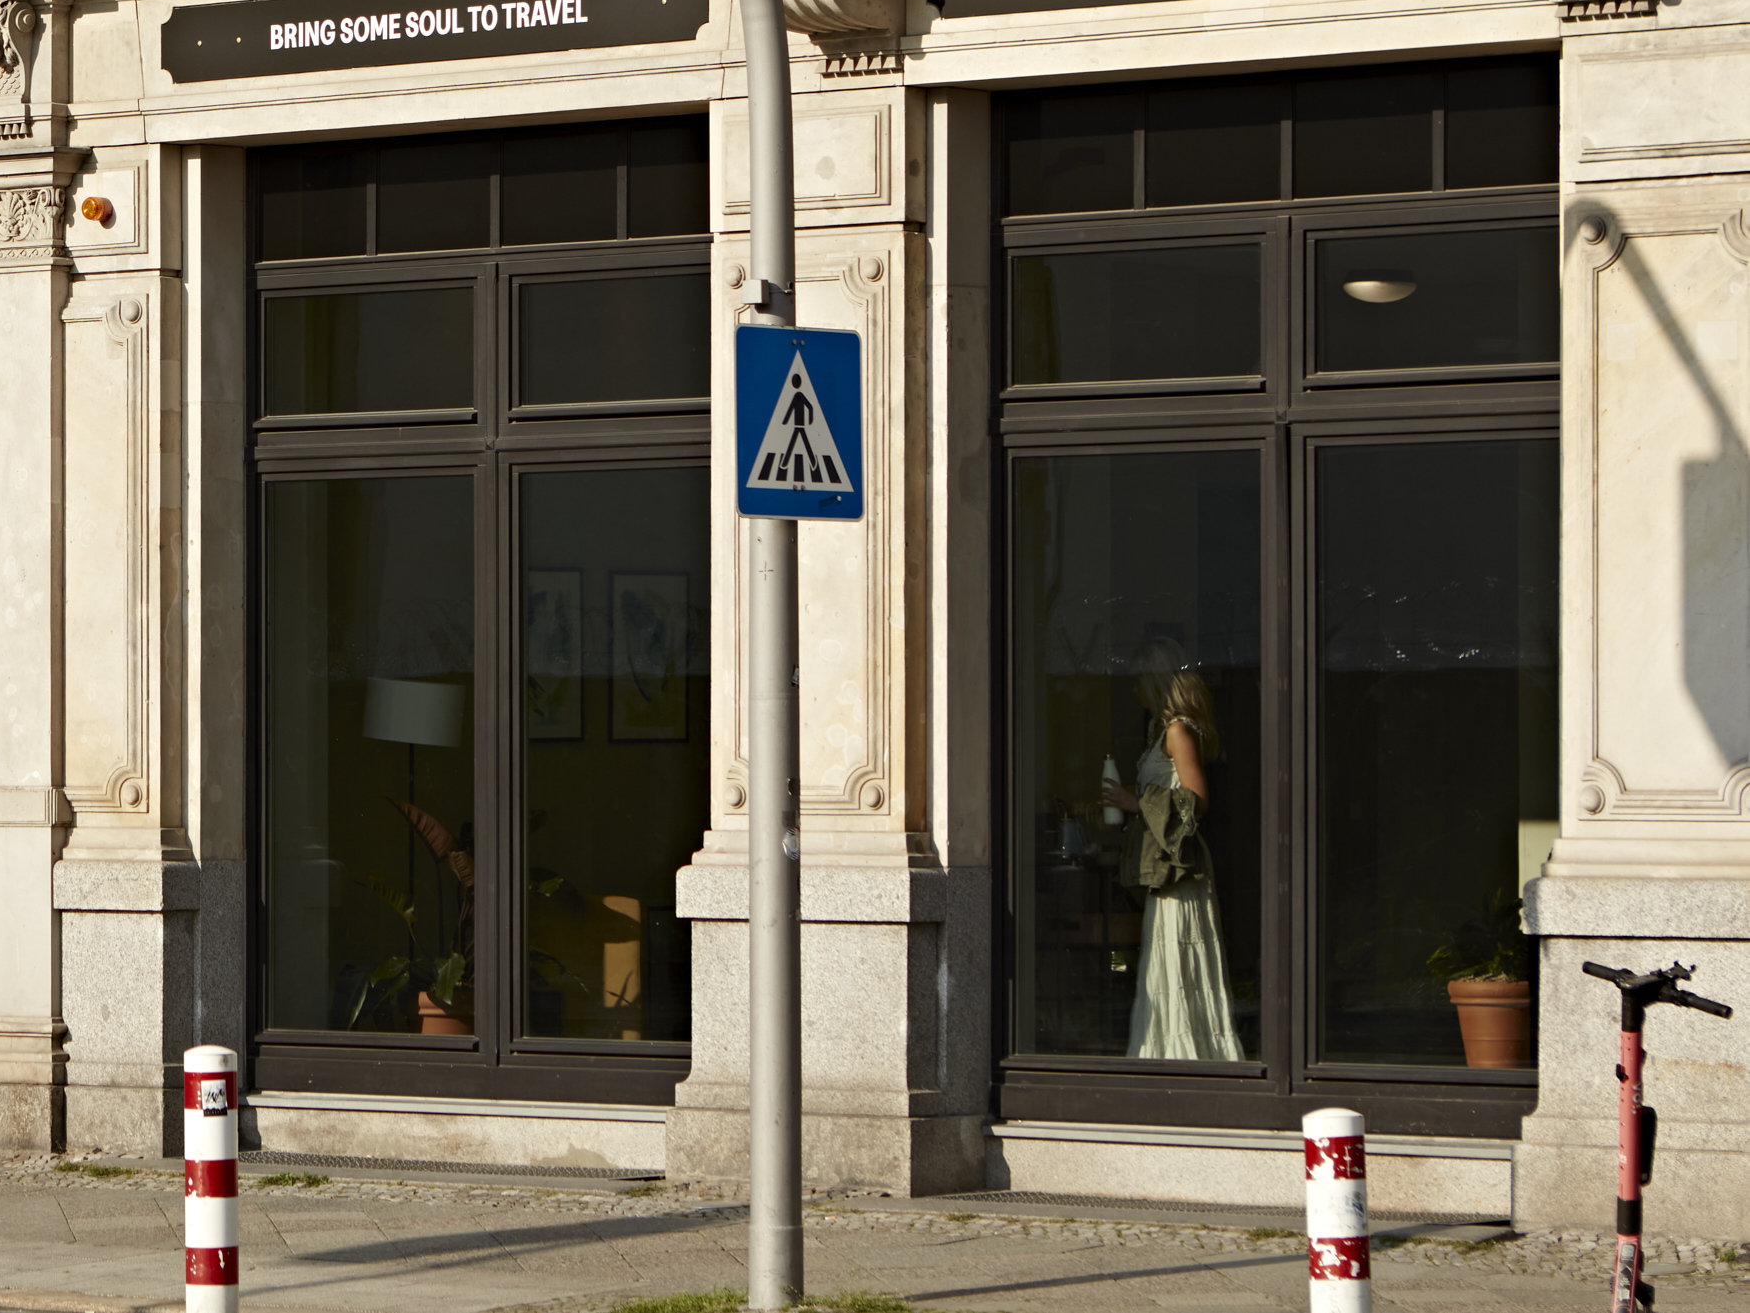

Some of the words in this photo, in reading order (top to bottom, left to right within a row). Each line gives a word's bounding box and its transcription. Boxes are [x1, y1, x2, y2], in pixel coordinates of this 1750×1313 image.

[270, 19, 336, 51] BRING
[340, 13, 401, 44] SOME
[405, 8, 465, 38] SOUL
[467, 4, 499, 33] TO
